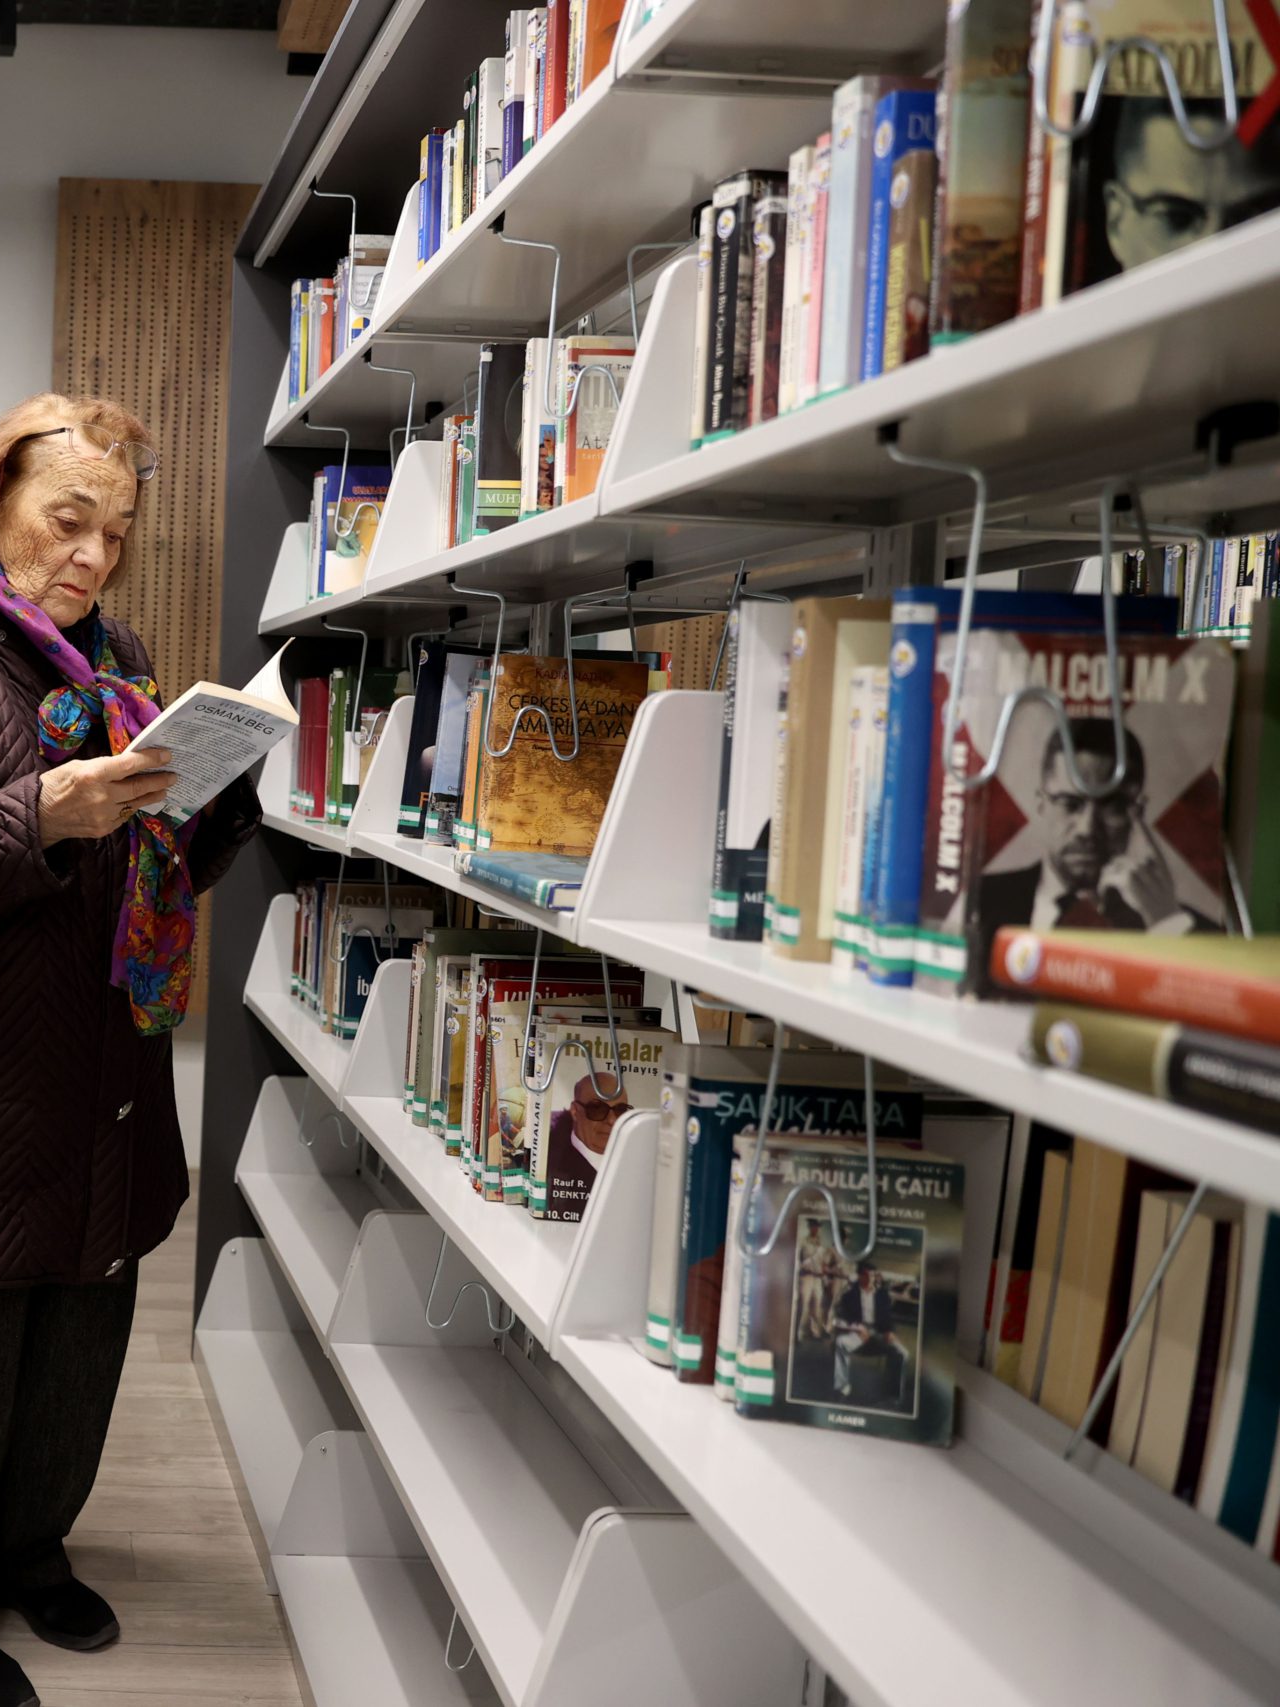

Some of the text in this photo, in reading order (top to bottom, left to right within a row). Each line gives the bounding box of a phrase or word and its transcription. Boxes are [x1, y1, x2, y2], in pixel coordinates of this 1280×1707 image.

[1178, 655, 1210, 704] X
[194, 704, 245, 723] OSMAN
[244, 718, 275, 735] BEG
[565, 1032, 663, 1064] Hatıalar
[531, 1101, 541, 1178] HATIRALAR
[552, 1190, 591, 1201] DENKTA
[553, 1178, 575, 1188] Rauf
[783, 1167, 951, 1200] ABDULLAH ÇATLI
[546, 1210, 580, 1221] 10. Cilt
[878, 1206, 925, 1220] OSYASI
